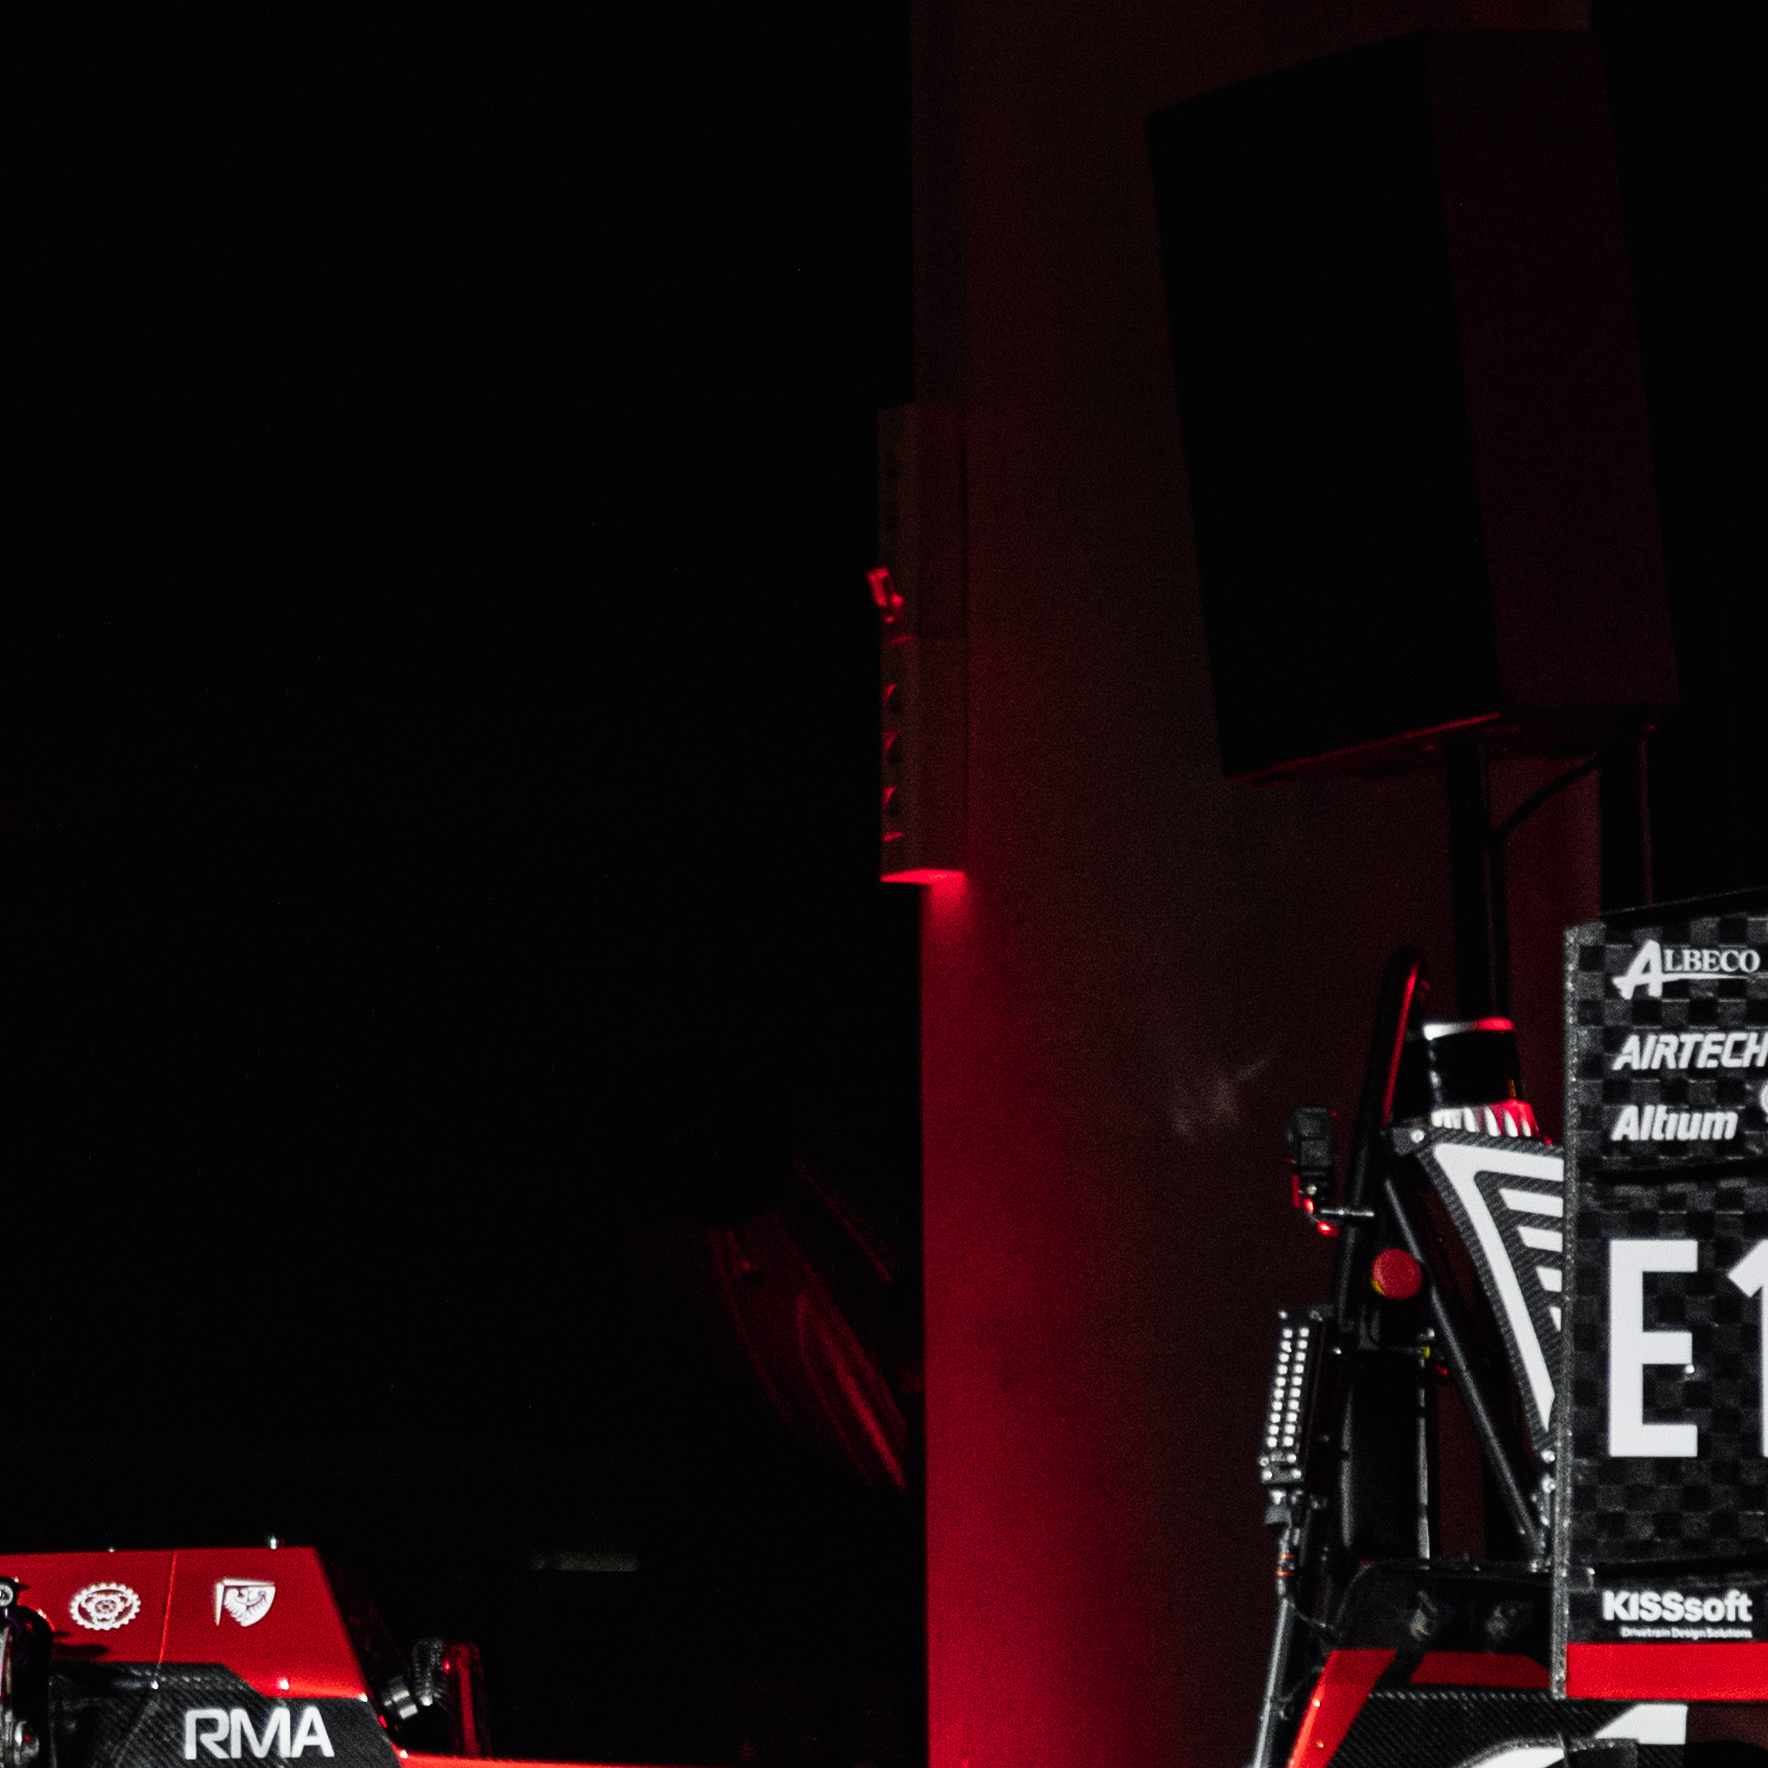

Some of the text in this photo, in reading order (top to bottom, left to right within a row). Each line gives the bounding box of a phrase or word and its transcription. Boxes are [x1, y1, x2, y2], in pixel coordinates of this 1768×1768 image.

[1613, 939, 1761, 1000] ALBECO
[1610, 1104, 1740, 1142] Altium
[1601, 1588, 1753, 1623] KISSsoft
[184, 1706, 335, 1761] RMA
